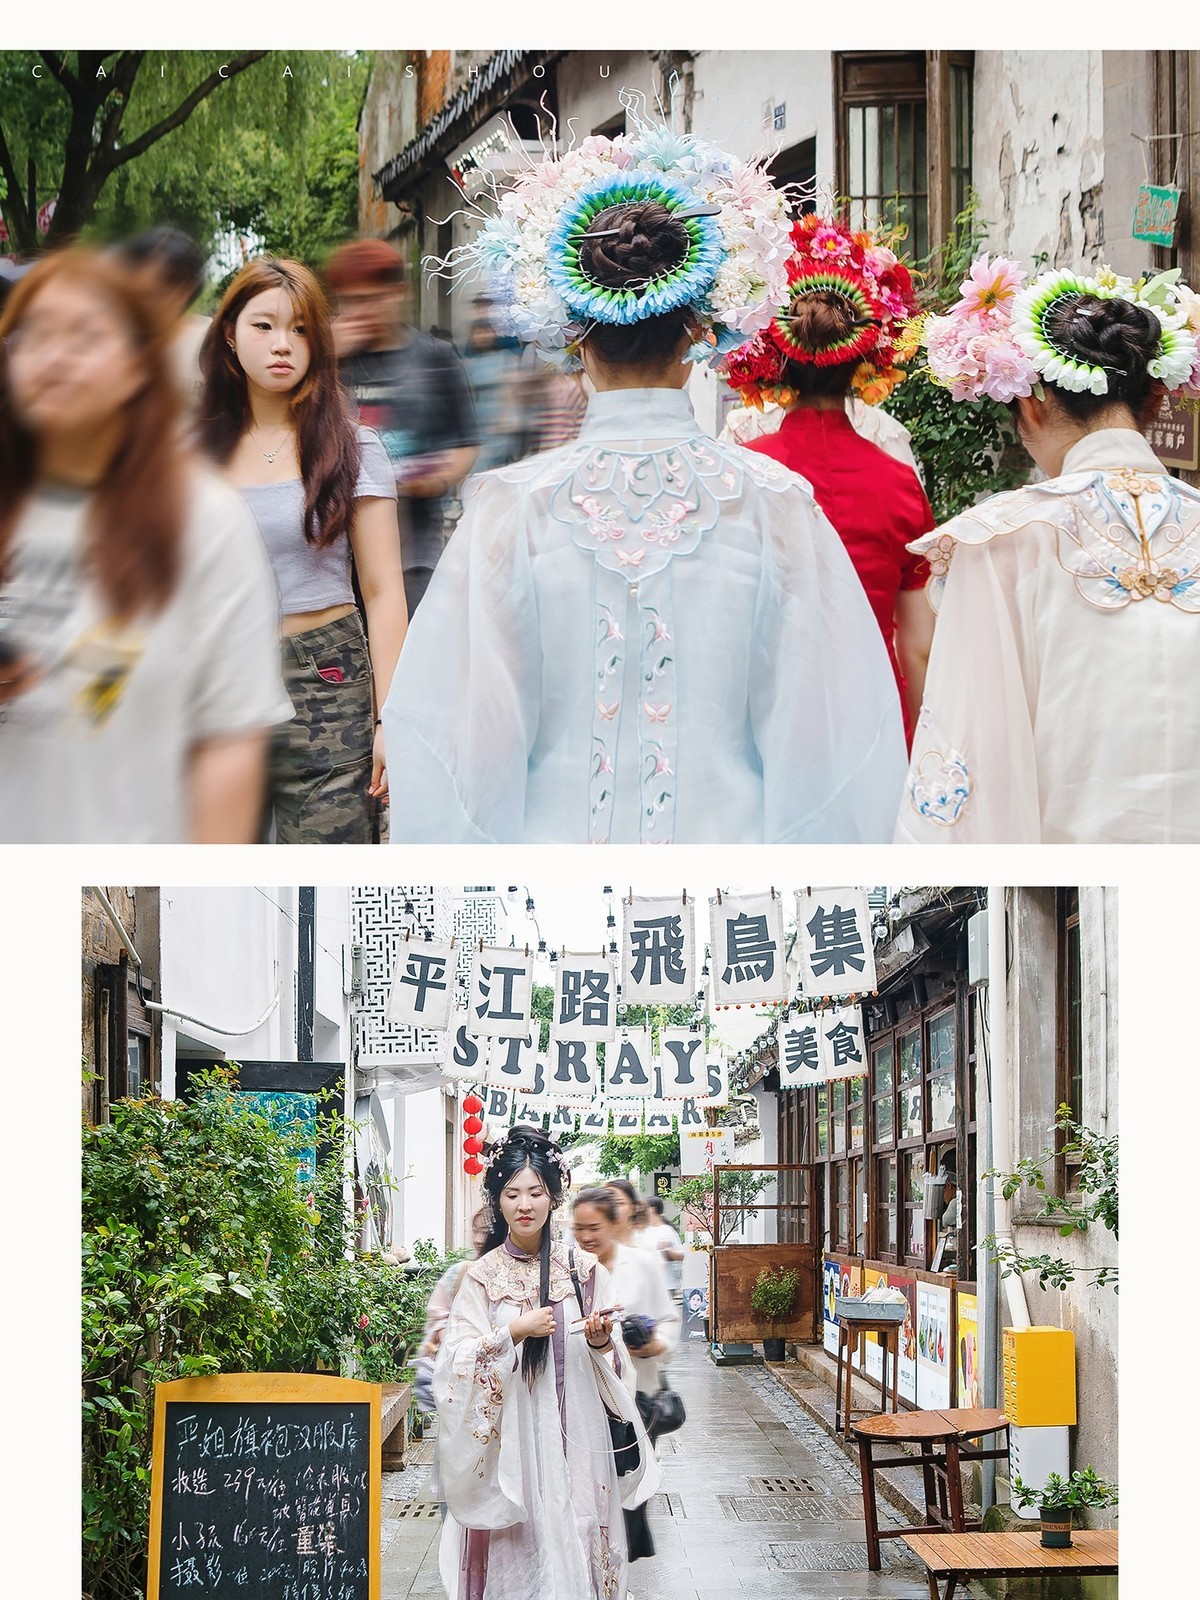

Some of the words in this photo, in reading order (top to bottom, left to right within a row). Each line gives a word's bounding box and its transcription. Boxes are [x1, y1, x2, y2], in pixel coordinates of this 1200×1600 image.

[630, 904, 866, 985] 飛鳥集
[400, 952, 609, 1027] 平江路
[453, 1025, 702, 1085] STRAY
[784, 1021, 862, 1074] 美食
[176, 1412, 362, 1460] 严姐旗袍汉服店
[171, 1521, 224, 1551] 小孩
[291, 1521, 345, 1556] 童装
